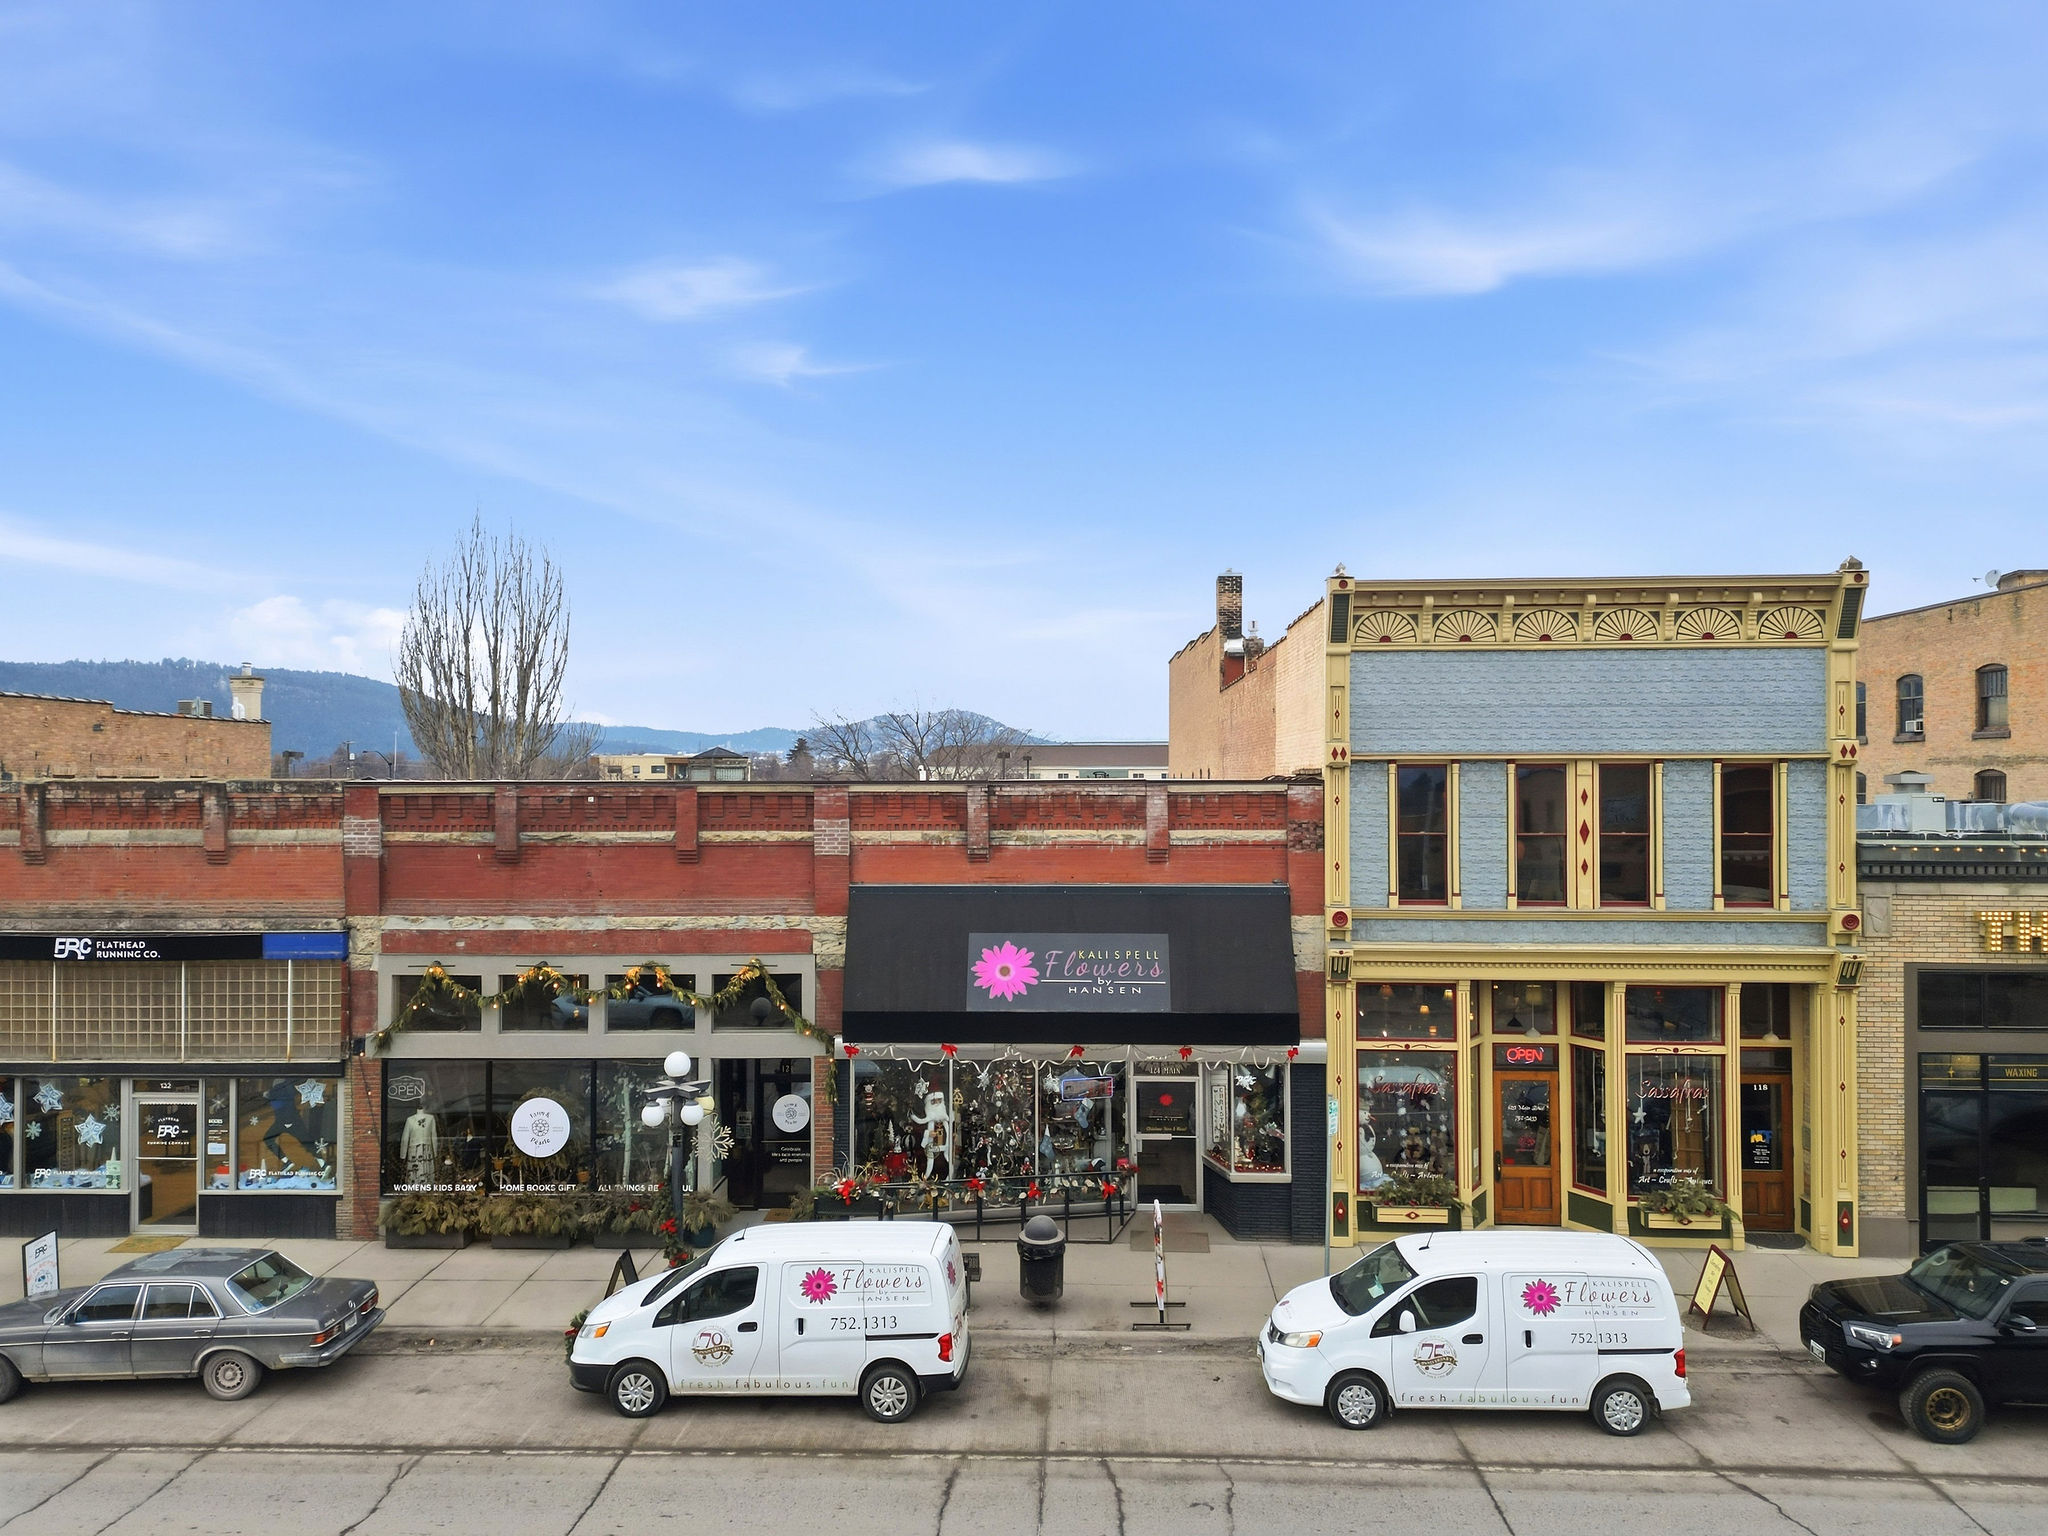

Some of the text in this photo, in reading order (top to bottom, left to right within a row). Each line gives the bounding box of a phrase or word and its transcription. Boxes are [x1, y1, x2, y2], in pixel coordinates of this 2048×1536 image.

[1977, 911, 2048, 952] TH
[96, 941, 146, 949] FLATHEAD
[96, 950, 161, 958] RUNNING CO.
[1078, 950, 1160, 960] KALISPELL
[1045, 950, 1164, 978] Flowers
[1097, 976, 1112, 986] by
[1068, 986, 1142, 994] HANSEN
[1506, 1047, 1543, 1062] OPEN
[2004, 1068, 2038, 1077] WAXING
[387, 1085, 424, 1096] OPEN
[1634, 1079, 1710, 1104] Sassafras
[393, 1184, 432, 1192] WOMENS
[433, 1184, 453, 1192] KIDS
[499, 1184, 578, 1192] HOME BOOKS GIFT
[869, 1266, 922, 1274] KALISPELL
[842, 1269, 924, 1290] Flowers
[1592, 1280, 1648, 1288] KALISPELL
[1564, 1281, 1653, 1303] Flowers
[830, 1315, 898, 1330] 752.1313
[1570, 1332, 1629, 1344] 752.1313
